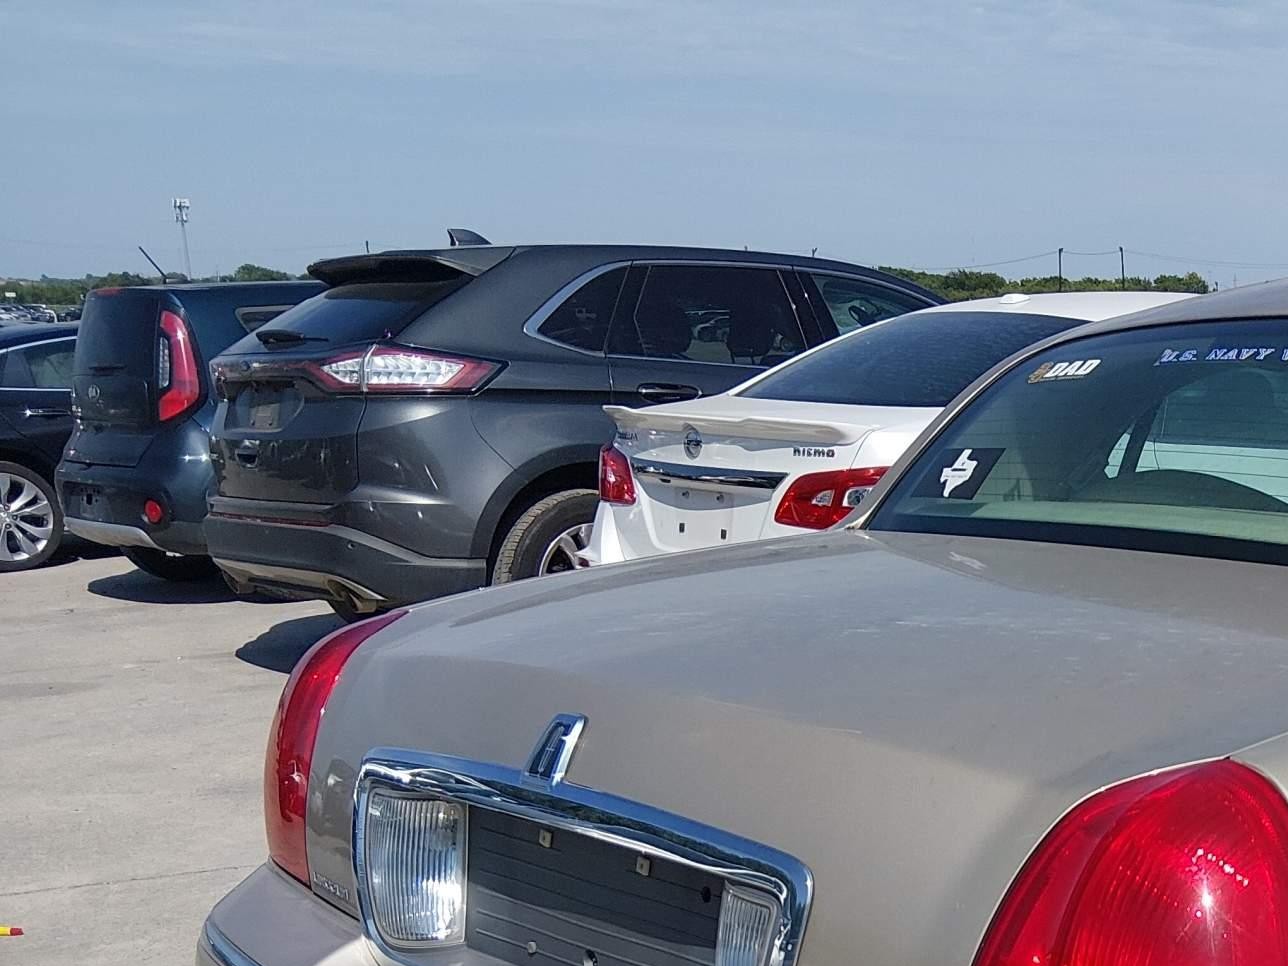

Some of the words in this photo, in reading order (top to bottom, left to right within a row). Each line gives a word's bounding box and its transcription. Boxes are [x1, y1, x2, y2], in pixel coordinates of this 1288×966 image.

[1157, 348, 1197, 363] U.S.
[1205, 348, 1275, 361] NAVY
[1043, 359, 1101, 378] DAD
